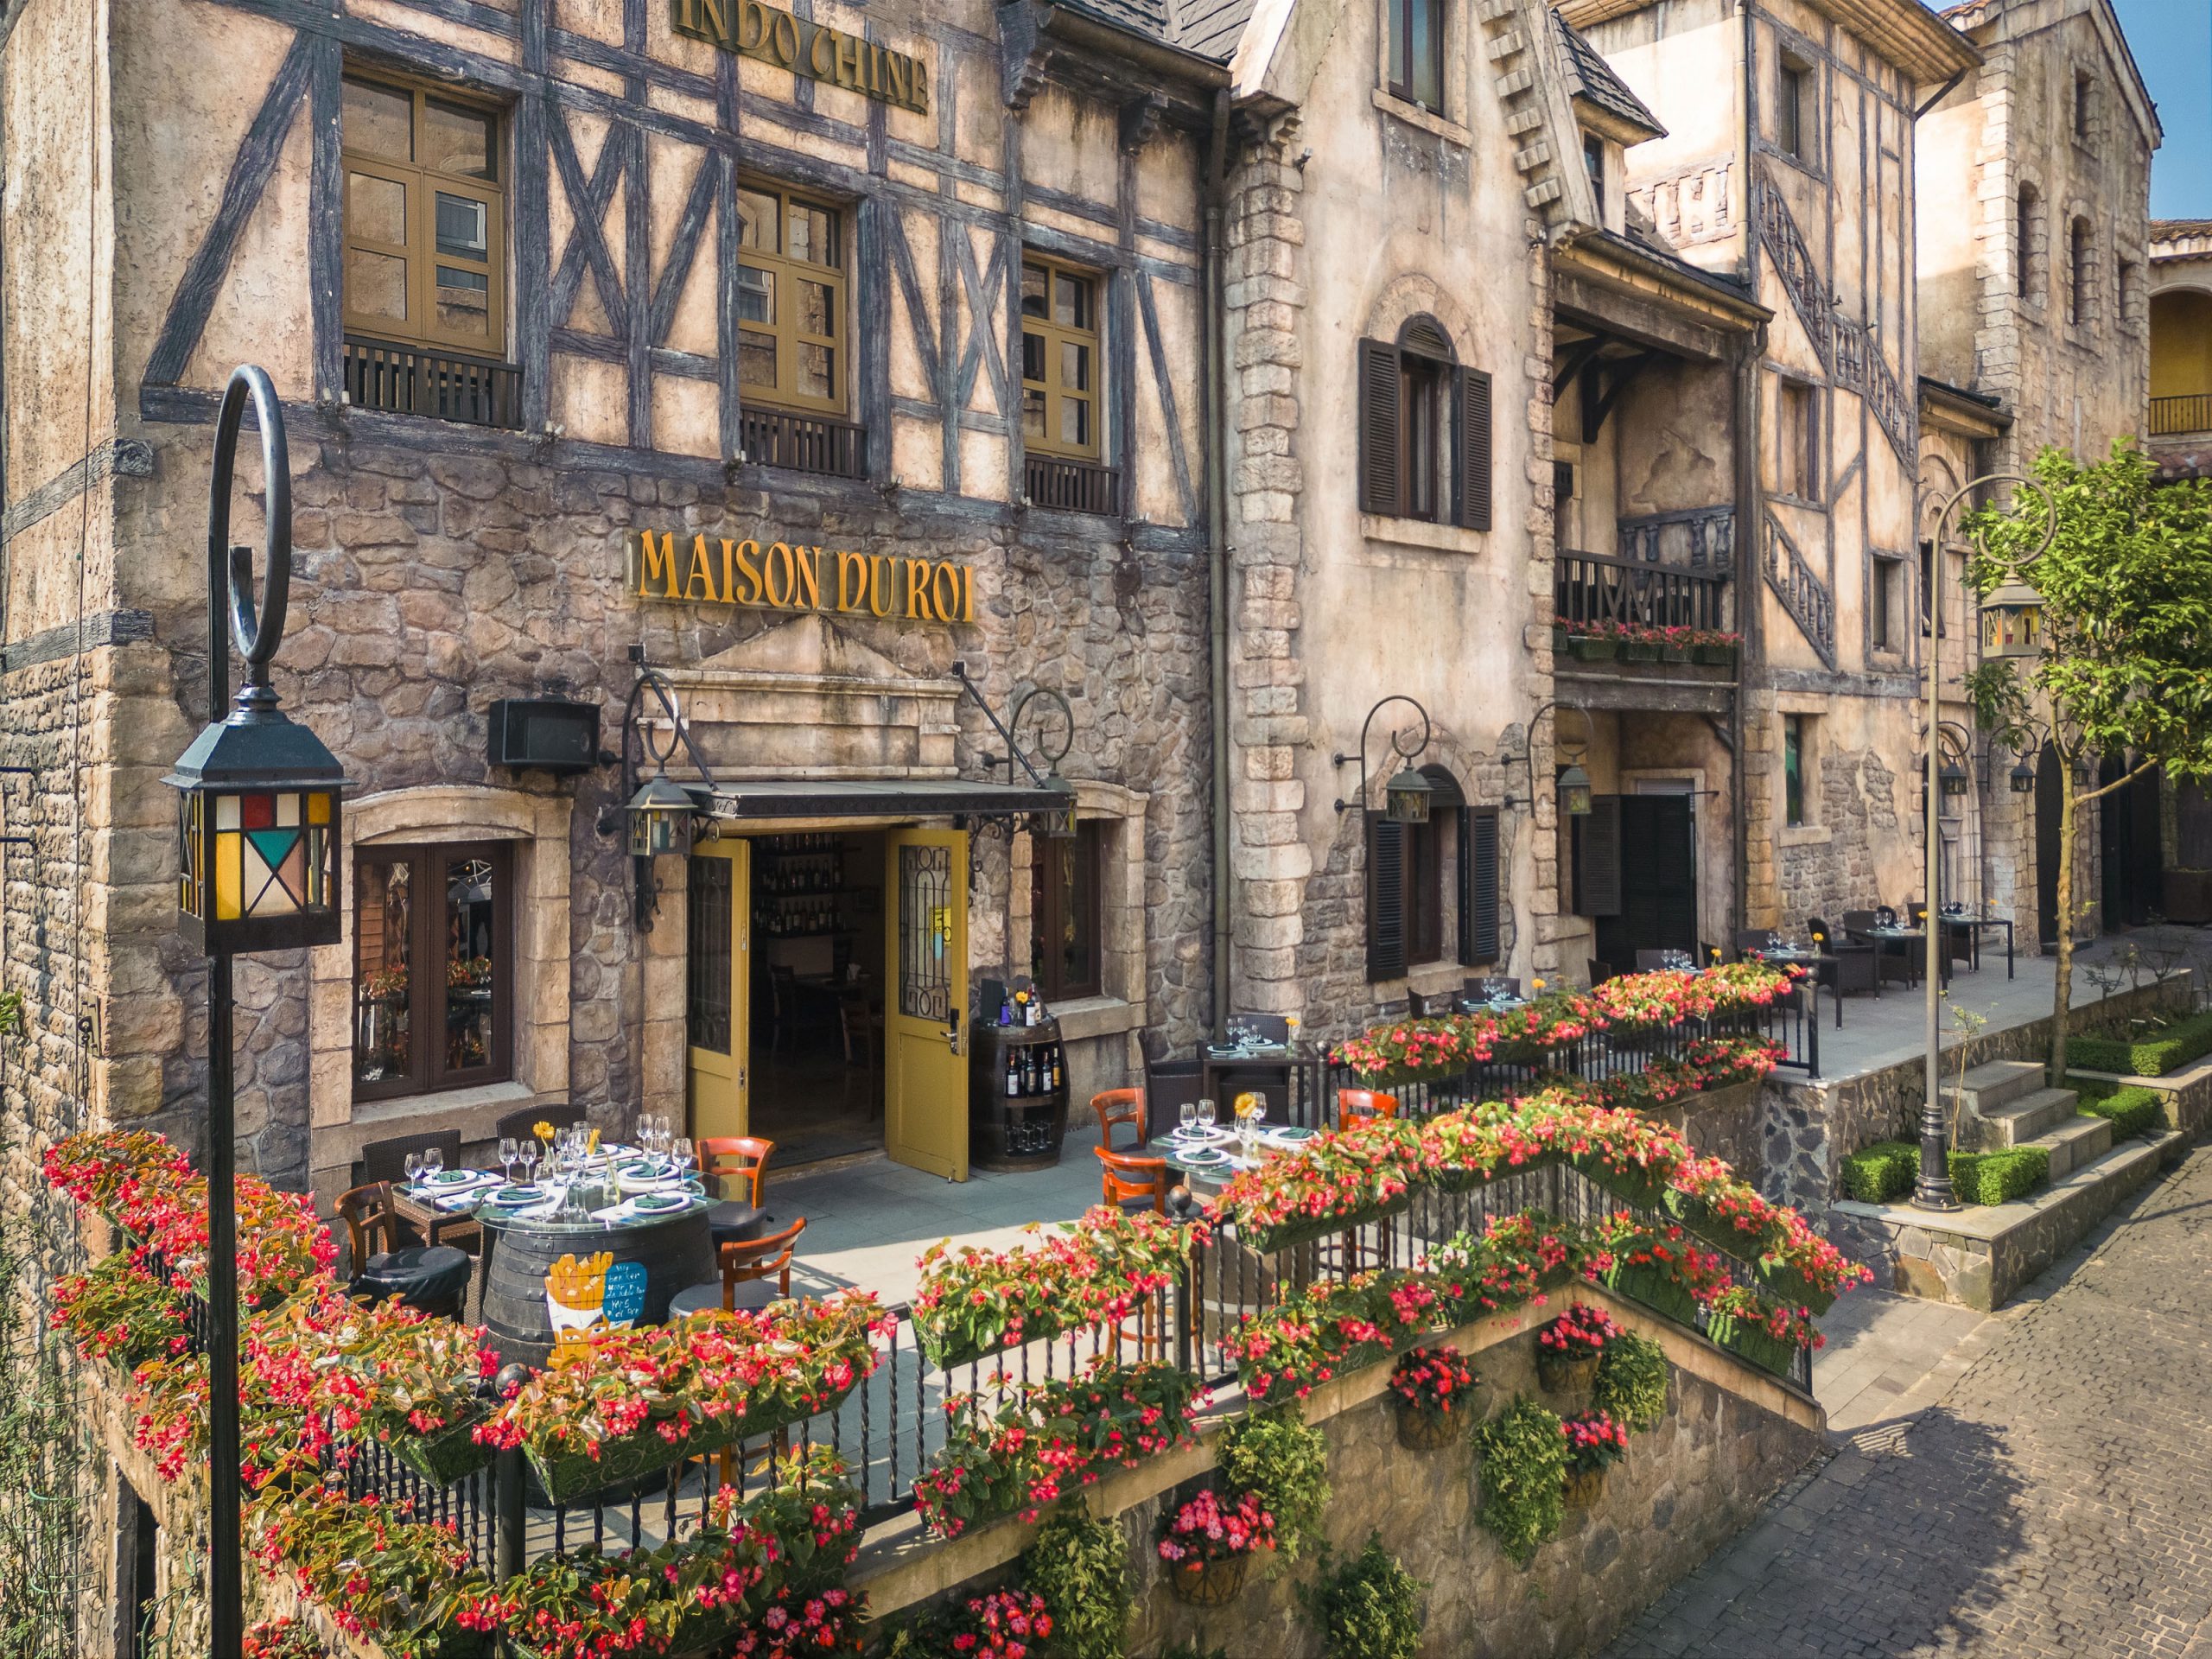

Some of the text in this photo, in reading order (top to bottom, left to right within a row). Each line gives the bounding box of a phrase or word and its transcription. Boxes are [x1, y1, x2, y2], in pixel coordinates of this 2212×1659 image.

[638, 529, 974, 622] MAISON DU ROI
